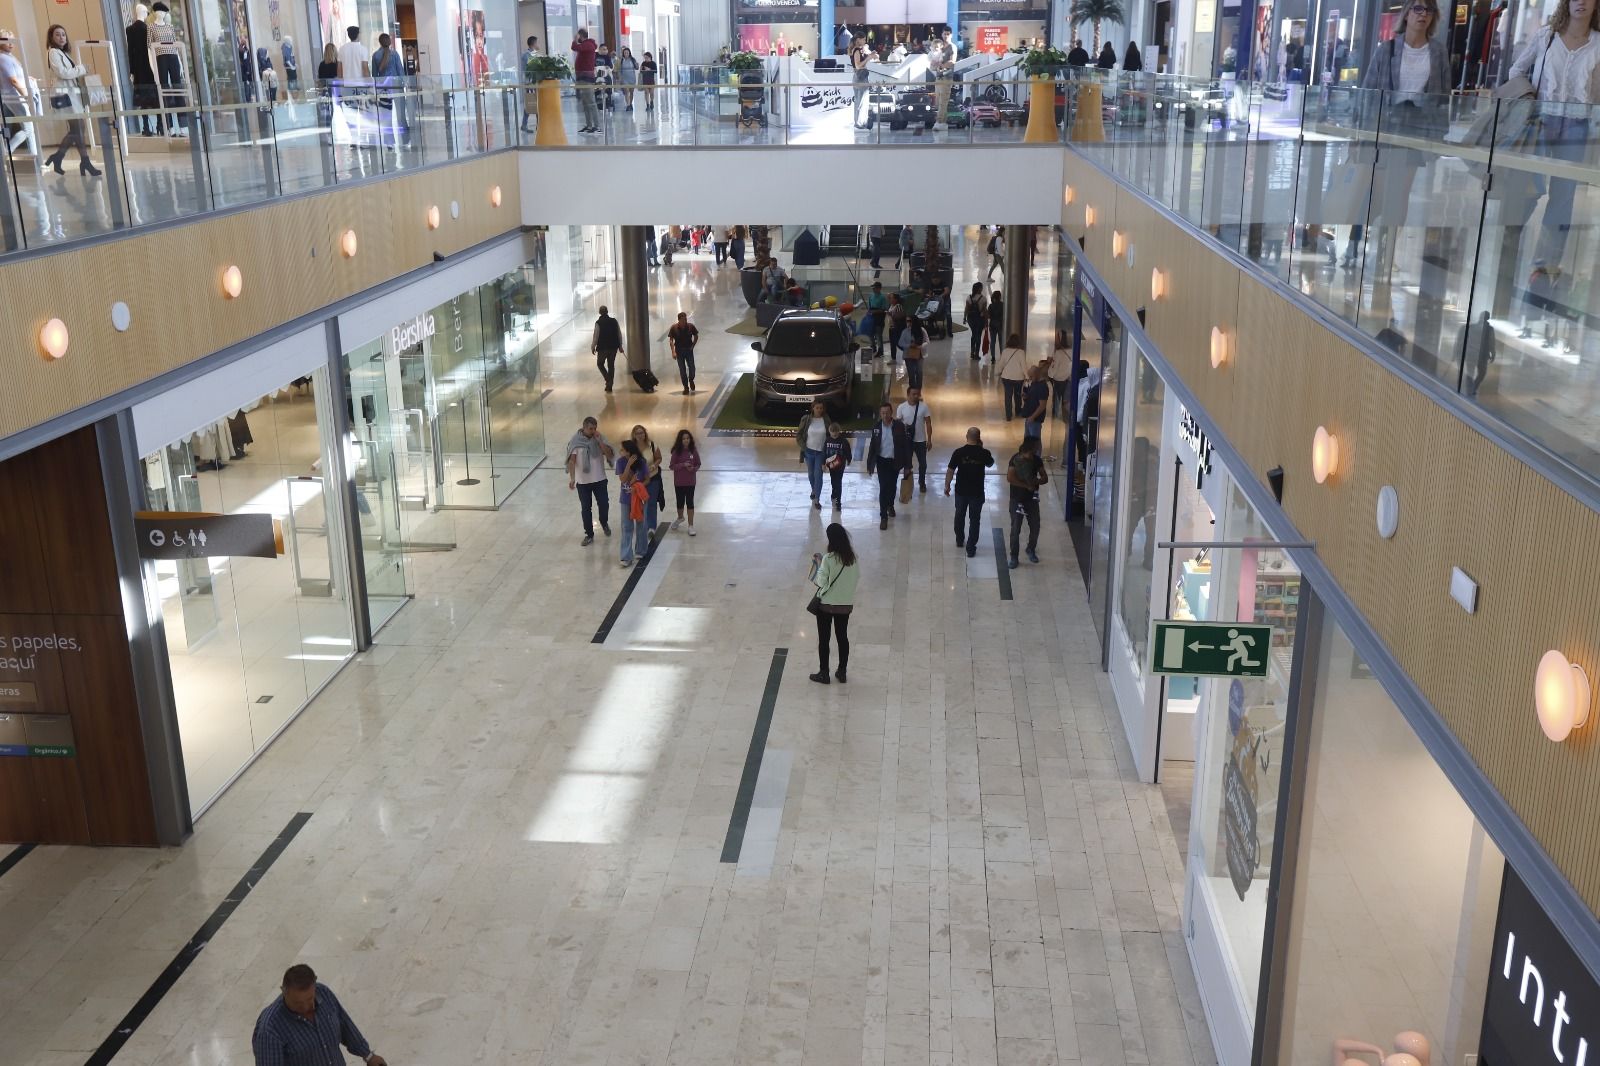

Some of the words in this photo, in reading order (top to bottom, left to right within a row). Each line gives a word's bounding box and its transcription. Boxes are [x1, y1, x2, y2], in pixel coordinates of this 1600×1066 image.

[391, 313, 436, 355] Bershka
[452, 295, 464, 353] Bers
[11, 632, 83, 653] papeles,
[0, 653, 36, 673] aquí
